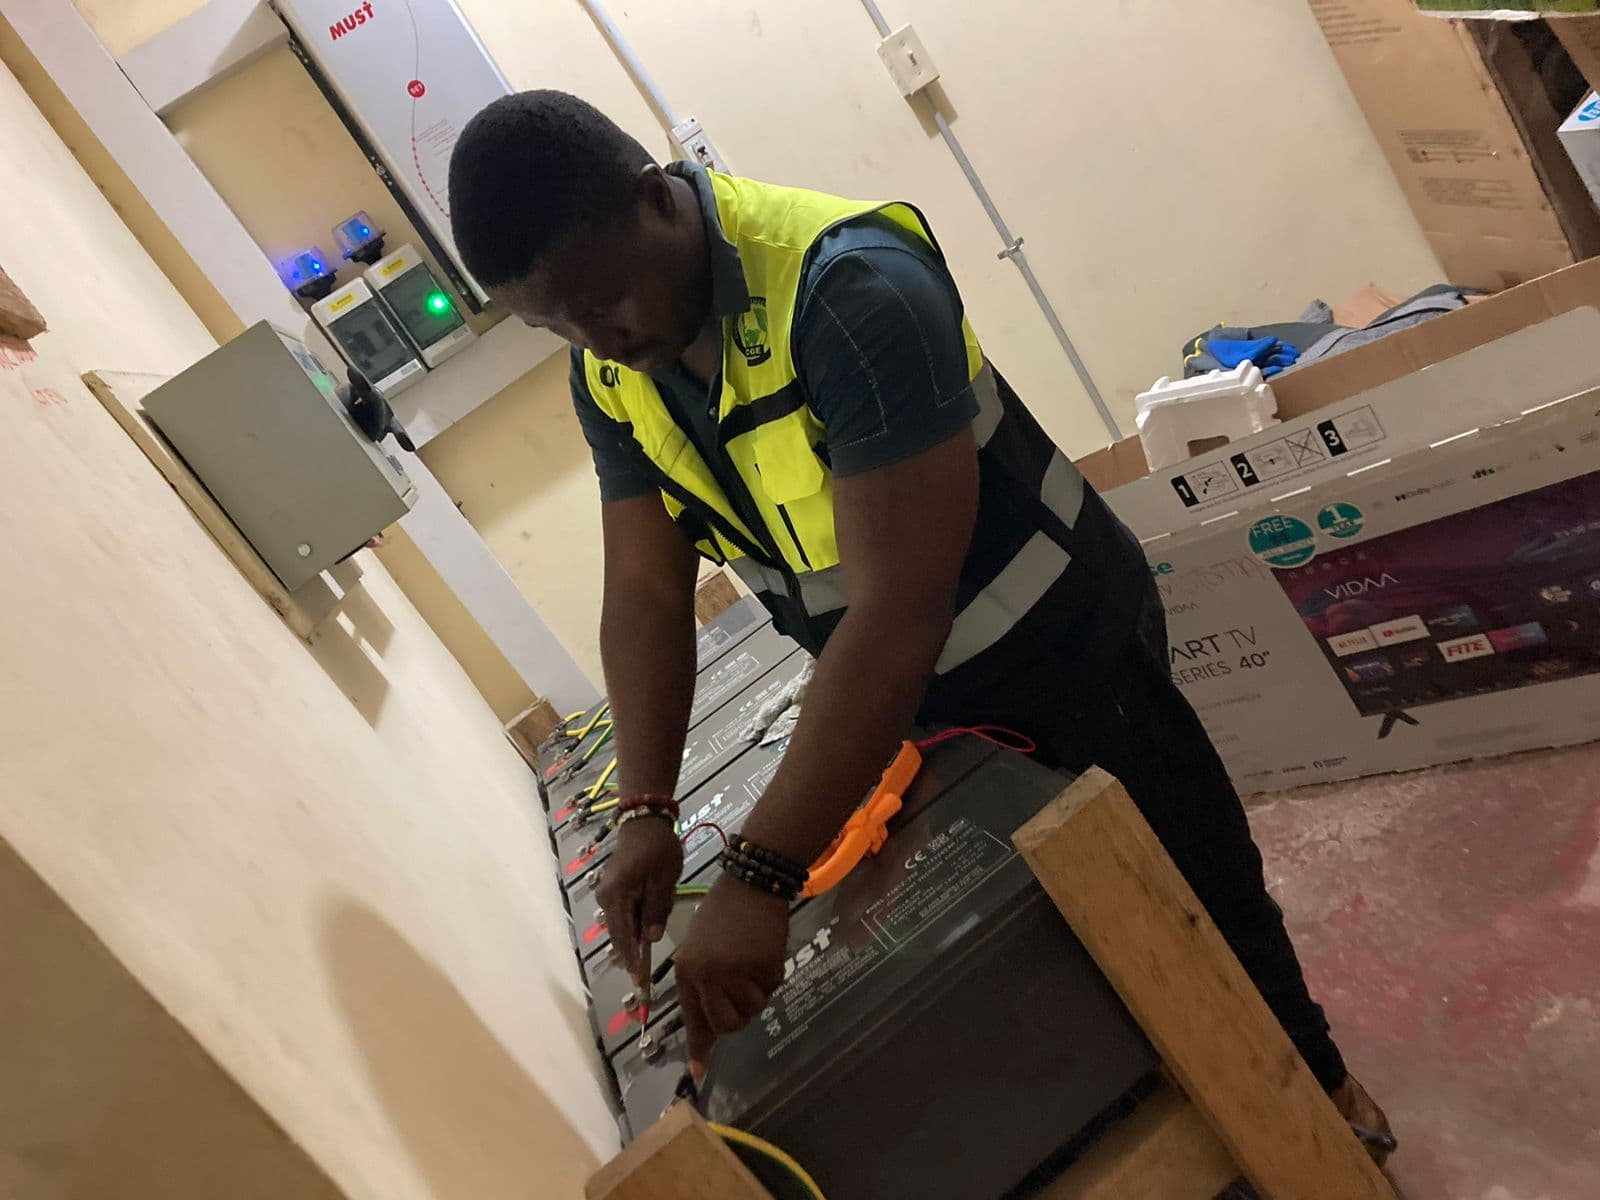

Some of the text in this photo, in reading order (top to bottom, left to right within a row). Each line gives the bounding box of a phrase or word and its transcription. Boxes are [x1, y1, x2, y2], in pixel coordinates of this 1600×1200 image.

[1324, 429, 1341, 447] 3
[1236, 462, 1253, 479] 2
[1177, 484, 1191, 499] 1
[1325, 504, 1348, 524] 1
[1251, 517, 1294, 538] FREE
[1170, 626, 1257, 664] ART TV
